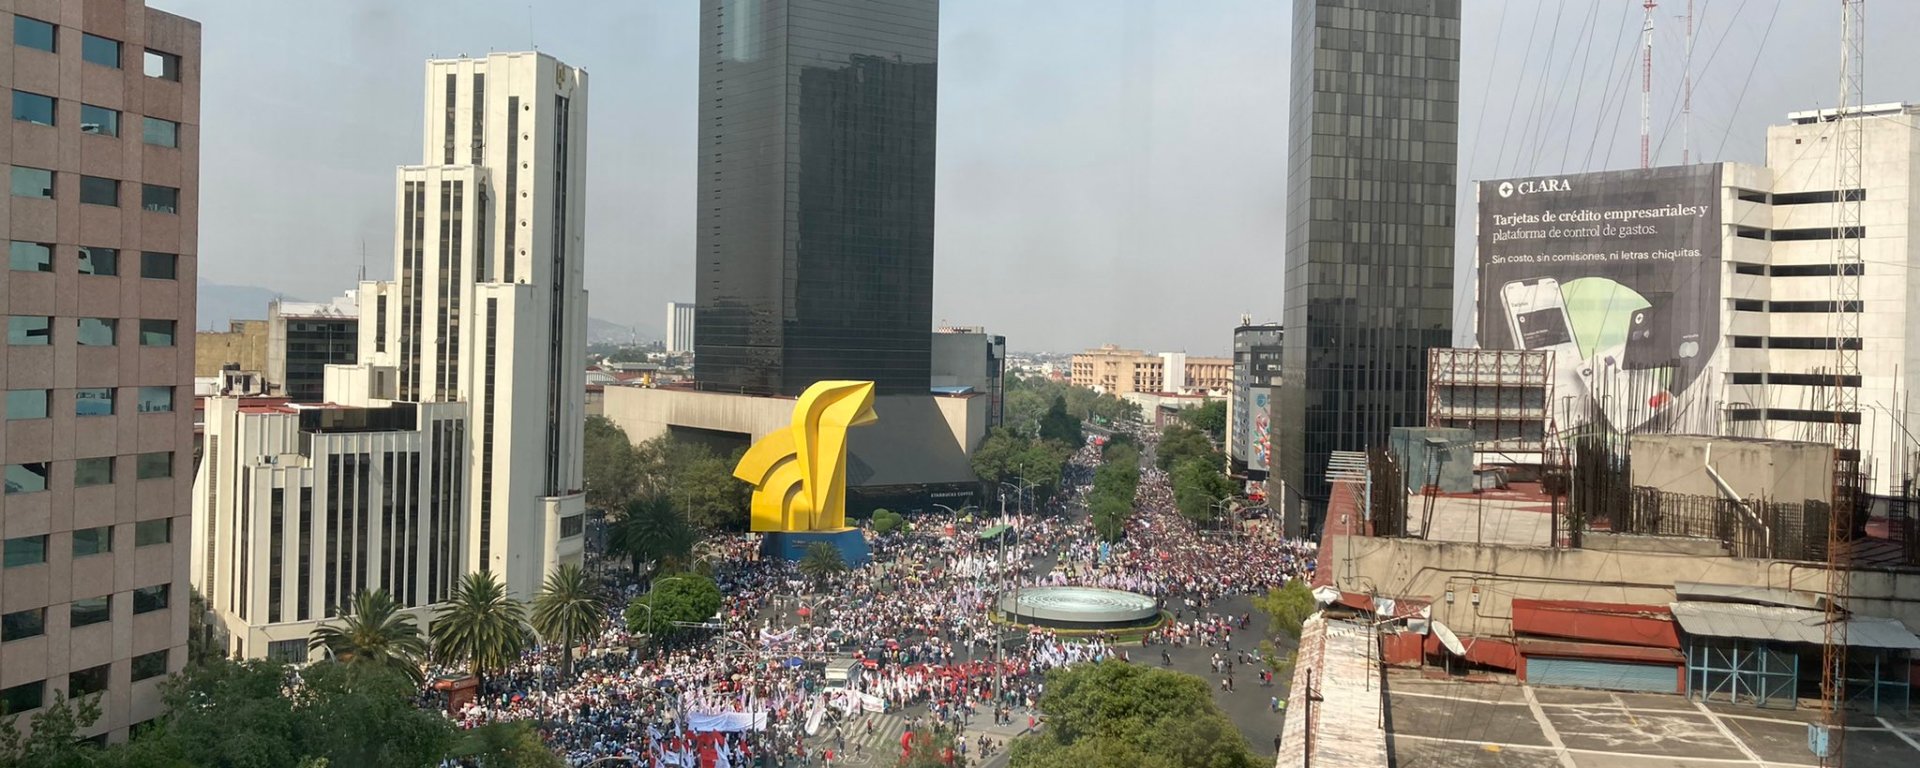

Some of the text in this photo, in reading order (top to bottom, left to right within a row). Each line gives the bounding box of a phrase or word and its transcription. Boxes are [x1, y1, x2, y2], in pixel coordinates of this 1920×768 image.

[1518, 179, 1571, 194] CLARA
[1493, 203, 1708, 227] Tarjetas de crédito empresariales y
[1492, 223, 1658, 244] plataforma de control de gastos.
[1492, 247, 1702, 264] Sin costo, sin comisiones, ni letras chiquitas.
